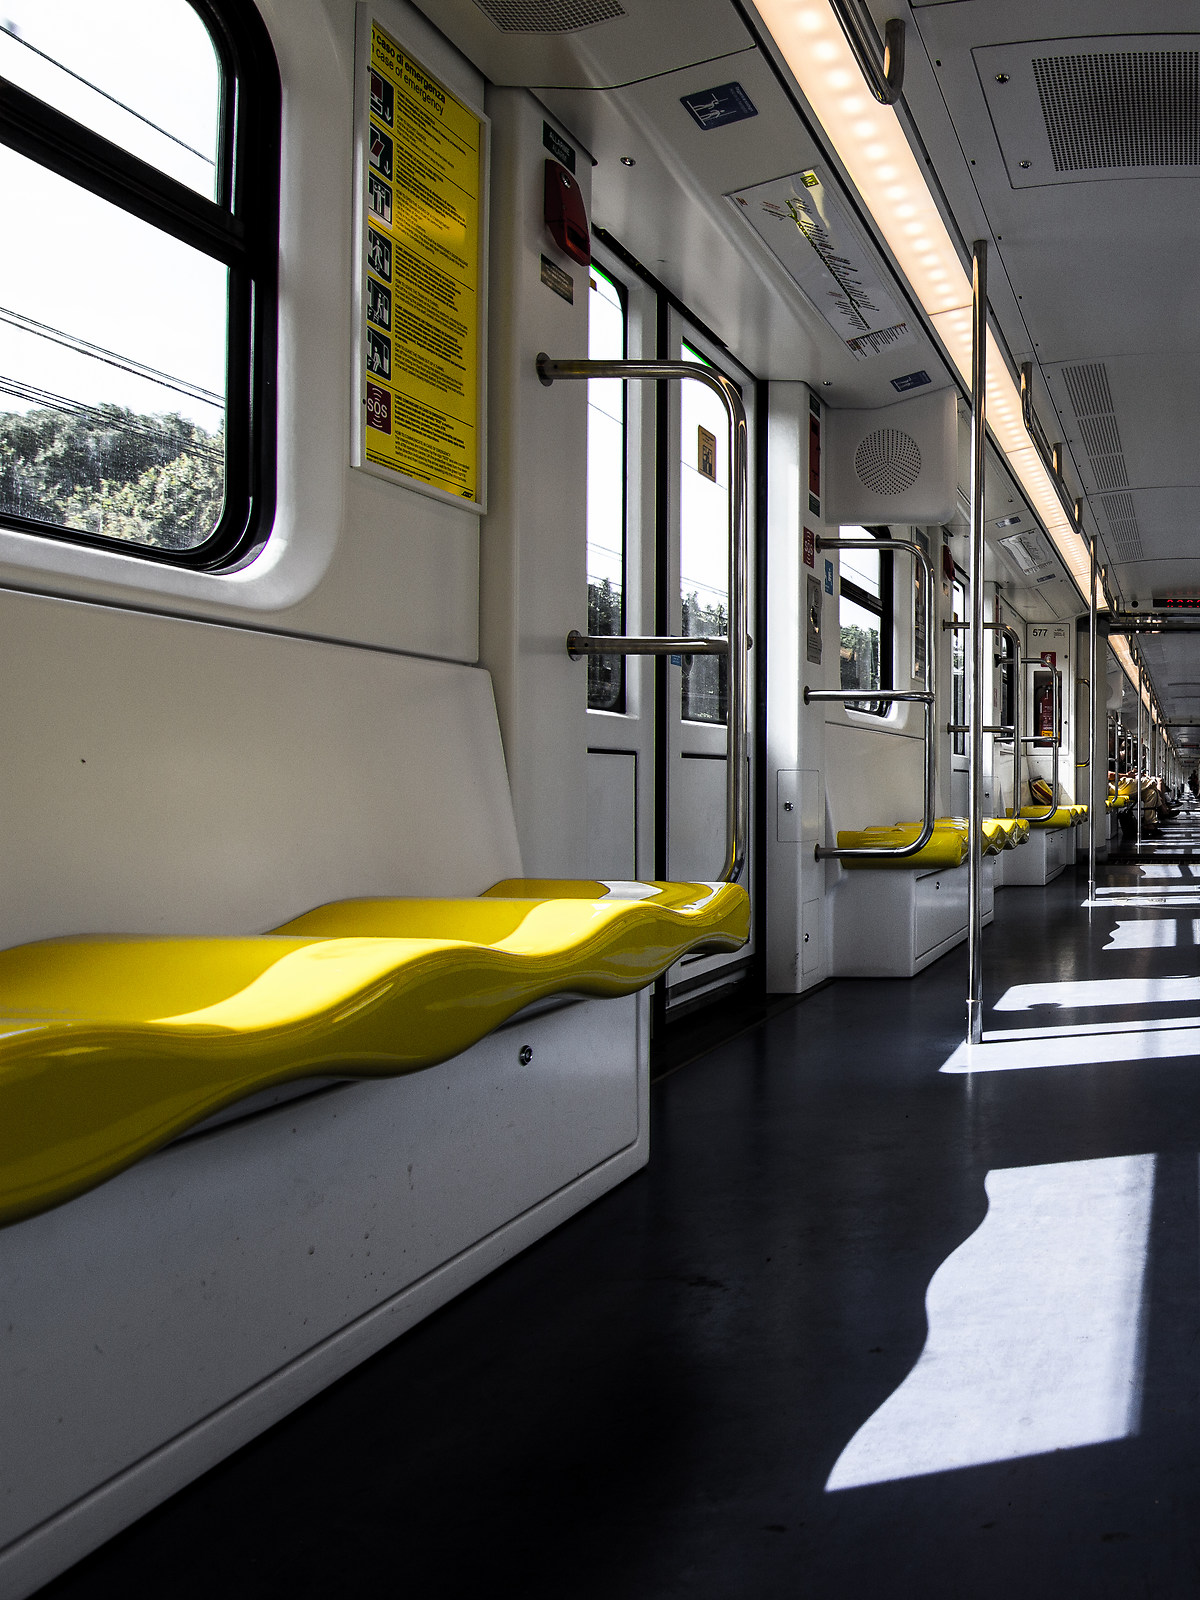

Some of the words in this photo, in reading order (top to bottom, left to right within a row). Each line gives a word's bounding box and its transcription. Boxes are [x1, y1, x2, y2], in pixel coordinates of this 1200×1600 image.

[376, 48, 394, 70] case
[395, 66, 403, 78] of
[403, 74, 443, 115] emergency
[377, 35, 395, 57] caso
[396, 53, 404, 65] di
[404, 61, 446, 104] emergenza
[367, 397, 388, 418] SOS
